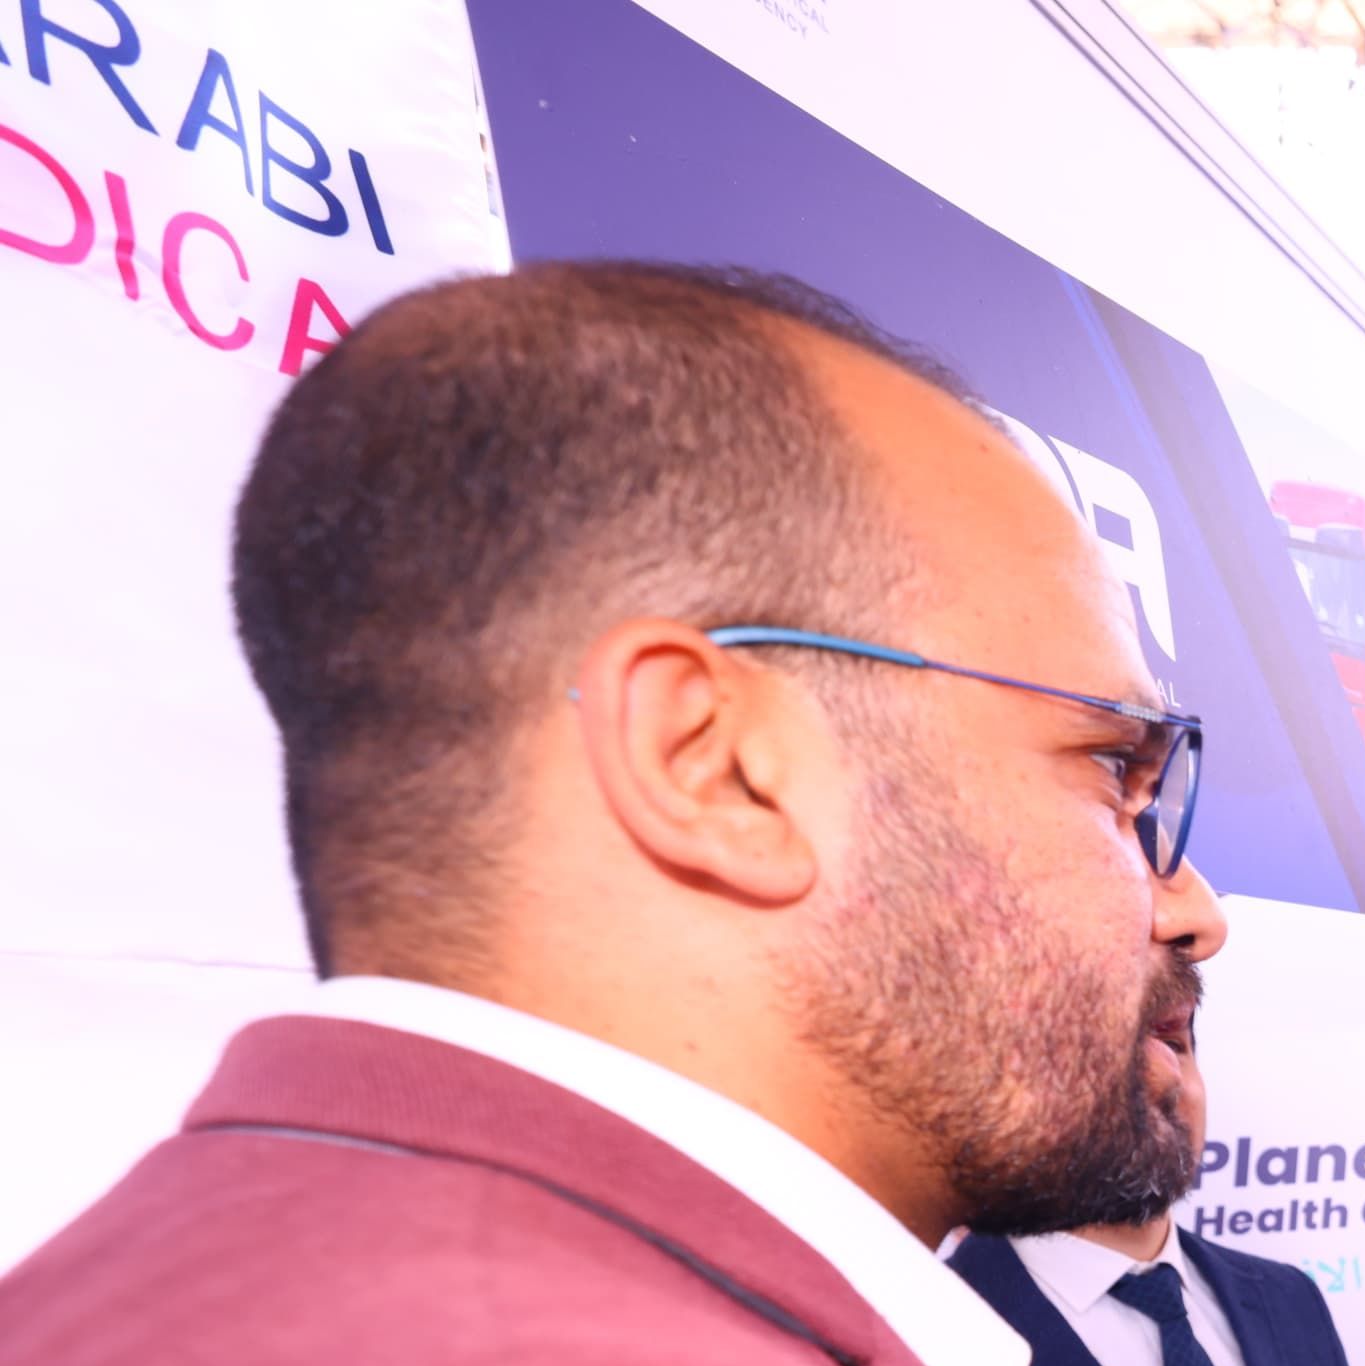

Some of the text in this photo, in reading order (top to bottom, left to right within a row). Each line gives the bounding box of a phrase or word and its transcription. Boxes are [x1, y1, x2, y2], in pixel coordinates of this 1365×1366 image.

[0, 0, 395, 255] RABI
[0, 125, 350, 378] DICA
[1193, 1198, 1349, 1237] Health
